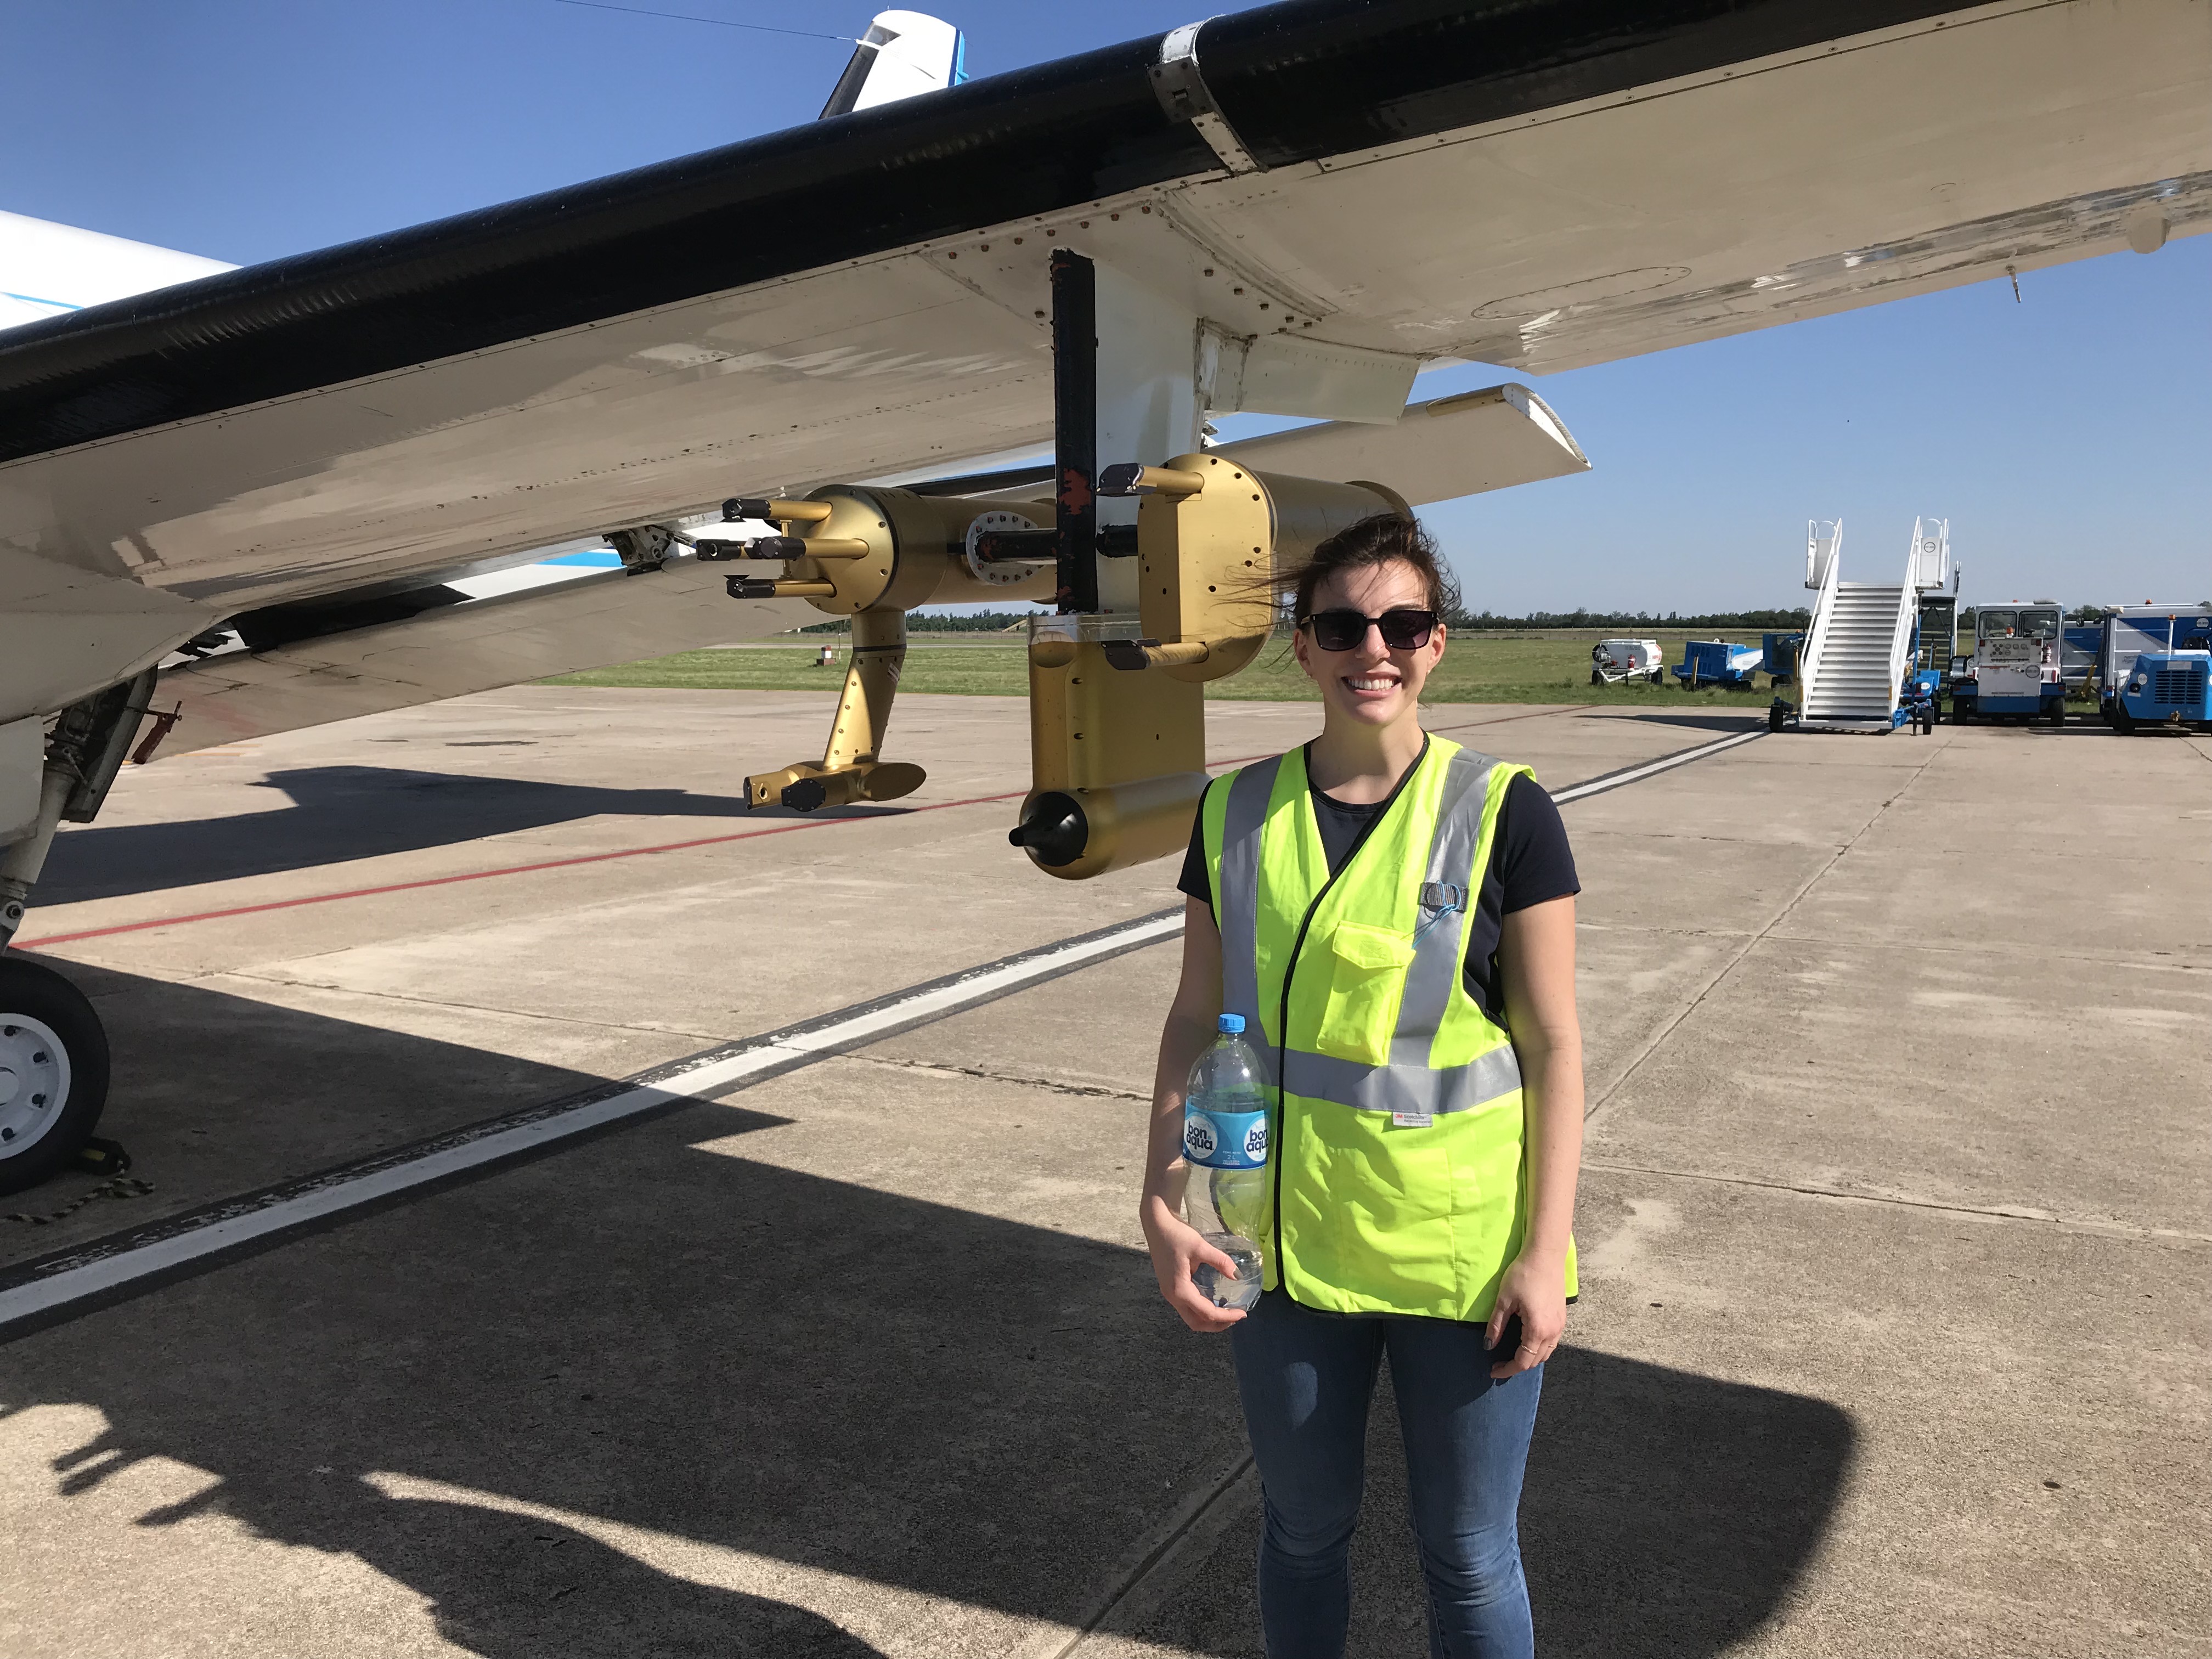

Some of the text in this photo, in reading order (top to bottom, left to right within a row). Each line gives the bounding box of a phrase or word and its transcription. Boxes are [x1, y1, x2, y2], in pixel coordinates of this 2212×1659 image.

[1188, 1121, 1207, 1139] bon
[1250, 1129, 1267, 1142] bon
[1187, 1133, 1212, 1150] aqua
